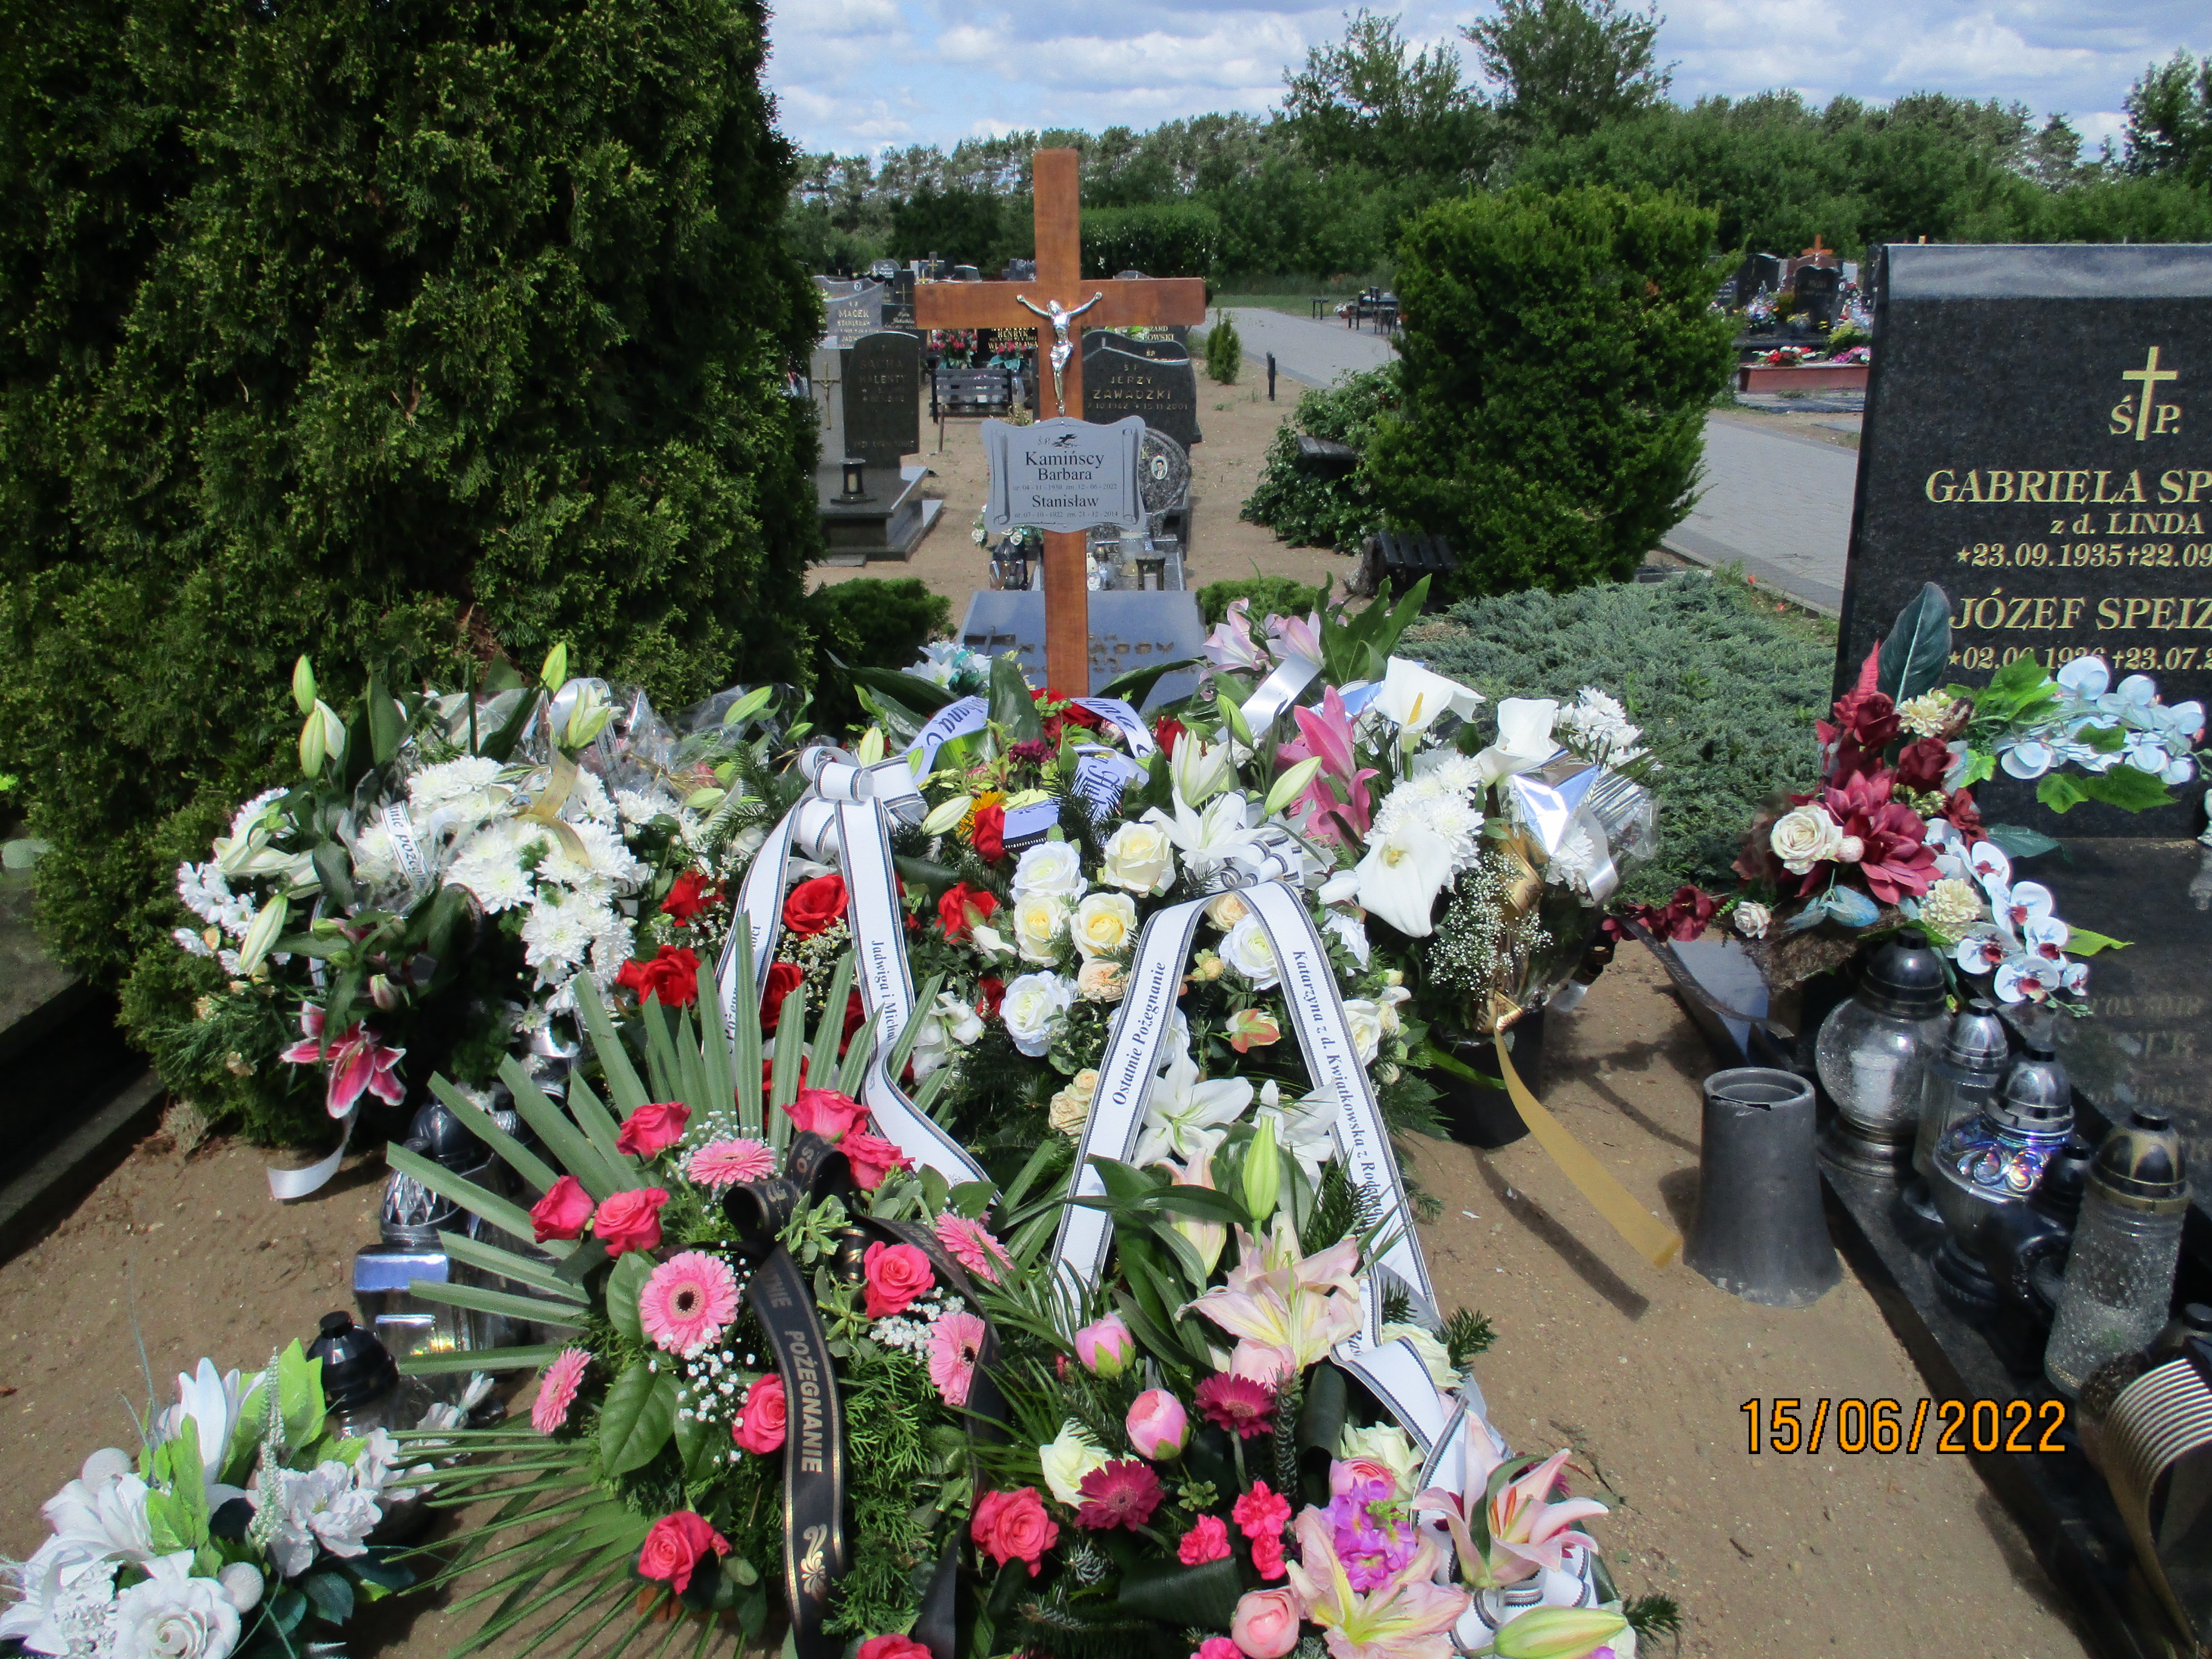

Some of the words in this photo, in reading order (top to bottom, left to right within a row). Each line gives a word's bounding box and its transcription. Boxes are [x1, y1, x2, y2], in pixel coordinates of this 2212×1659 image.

[1110, 376, 1153, 384] JERZY
[1093, 389, 1171, 400] ZAWADZKI
[1025, 451, 1104, 469] Kamińscy
[1038, 468, 1092, 480] Barbara
[1925, 469, 2148, 505] GABRIELA
[2157, 469, 2212, 505] SP
[1032, 494, 1099, 508] Stanisław
[2049, 520, 2065, 535] z
[2072, 513, 2096, 535] d.
[2105, 512, 2206, 535] LINDA
[1948, 587, 2088, 631] JÓZEF
[872, 940, 890, 991] Jadwiga
[1293, 950, 1324, 1022] Katarzyna
[1112, 1047, 1142, 1105] Ostatnie
[1132, 962, 1165, 1045] Pożegnanie
[1316, 1025, 1327, 1034] z
[1321, 1037, 1335, 1050] d.
[1327, 1054, 1366, 1147] Kwiatkowska
[1357, 1150, 1368, 1159] z
[784, 1330, 823, 1473] POŻEGNANIE
